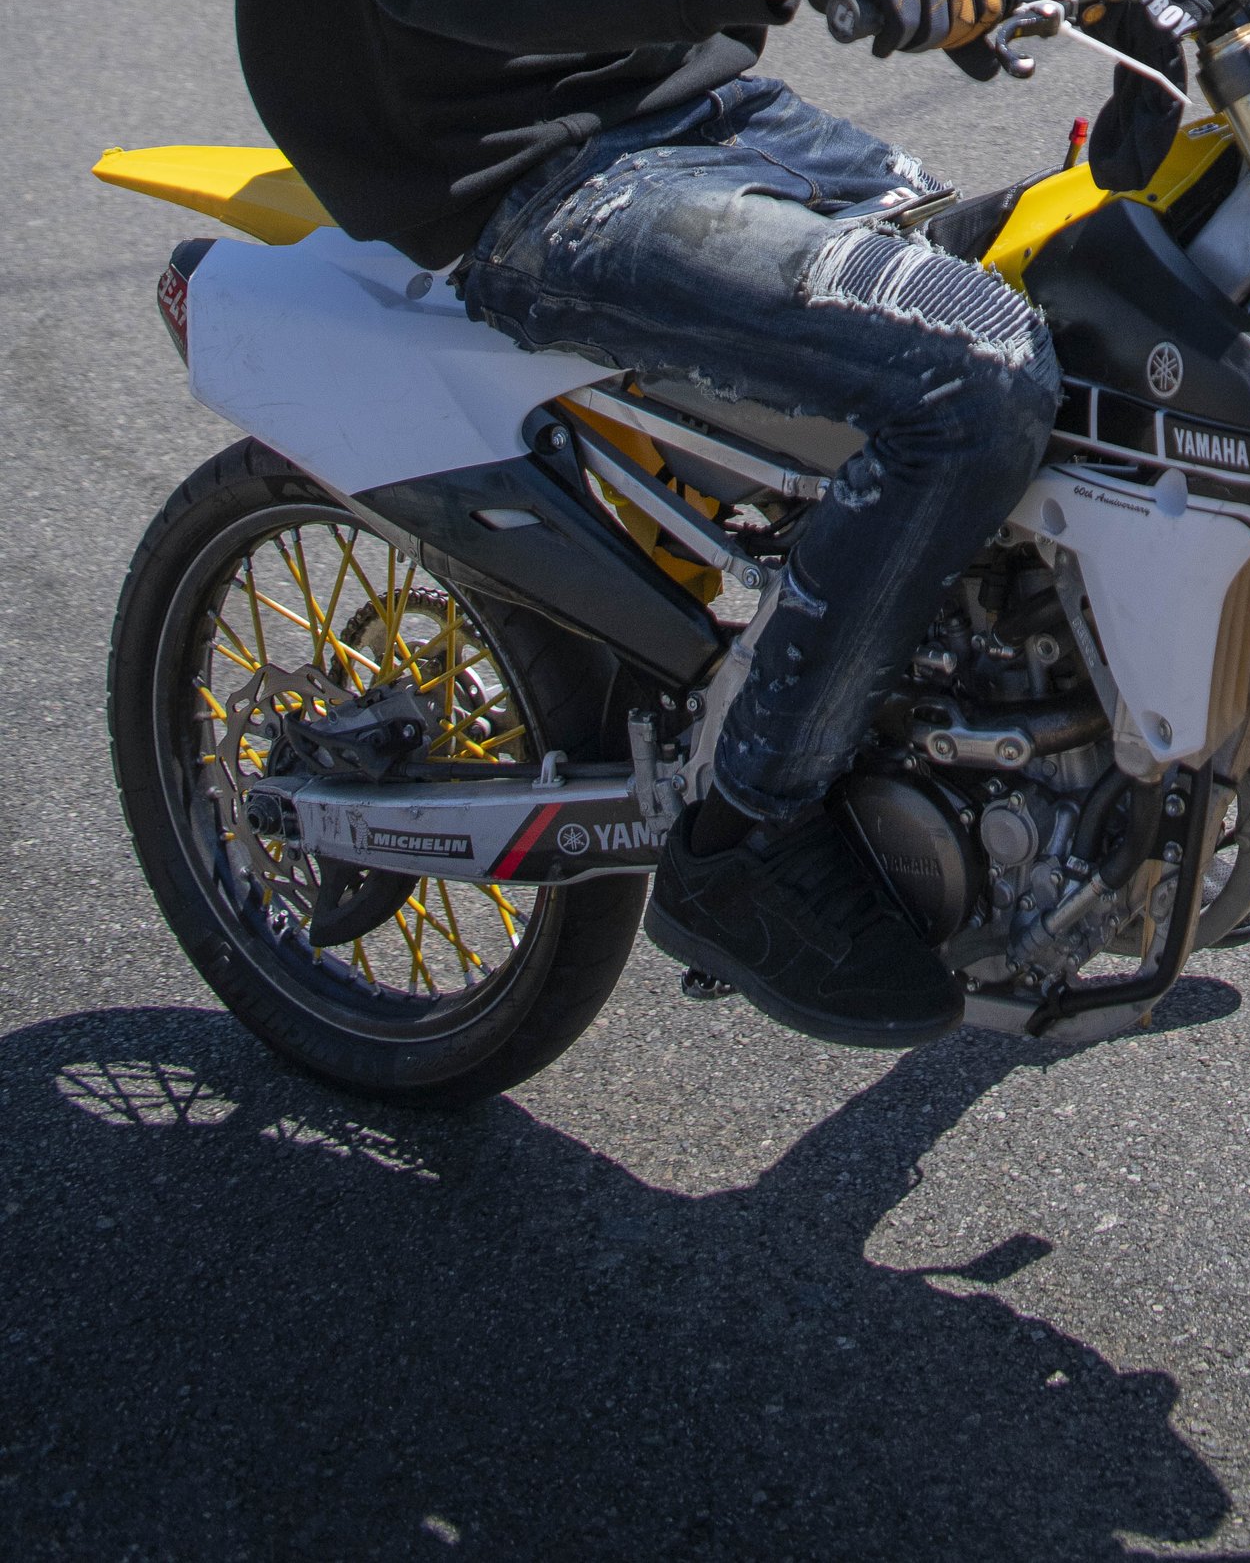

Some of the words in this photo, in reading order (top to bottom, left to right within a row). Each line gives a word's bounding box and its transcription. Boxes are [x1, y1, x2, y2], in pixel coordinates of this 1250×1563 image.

[1174, 427, 1249, 468] YAMAHA
[1073, 484, 1093, 498] 60th
[1095, 492, 1150, 516] Anniversary
[373, 832, 468, 853] MICHELIN
